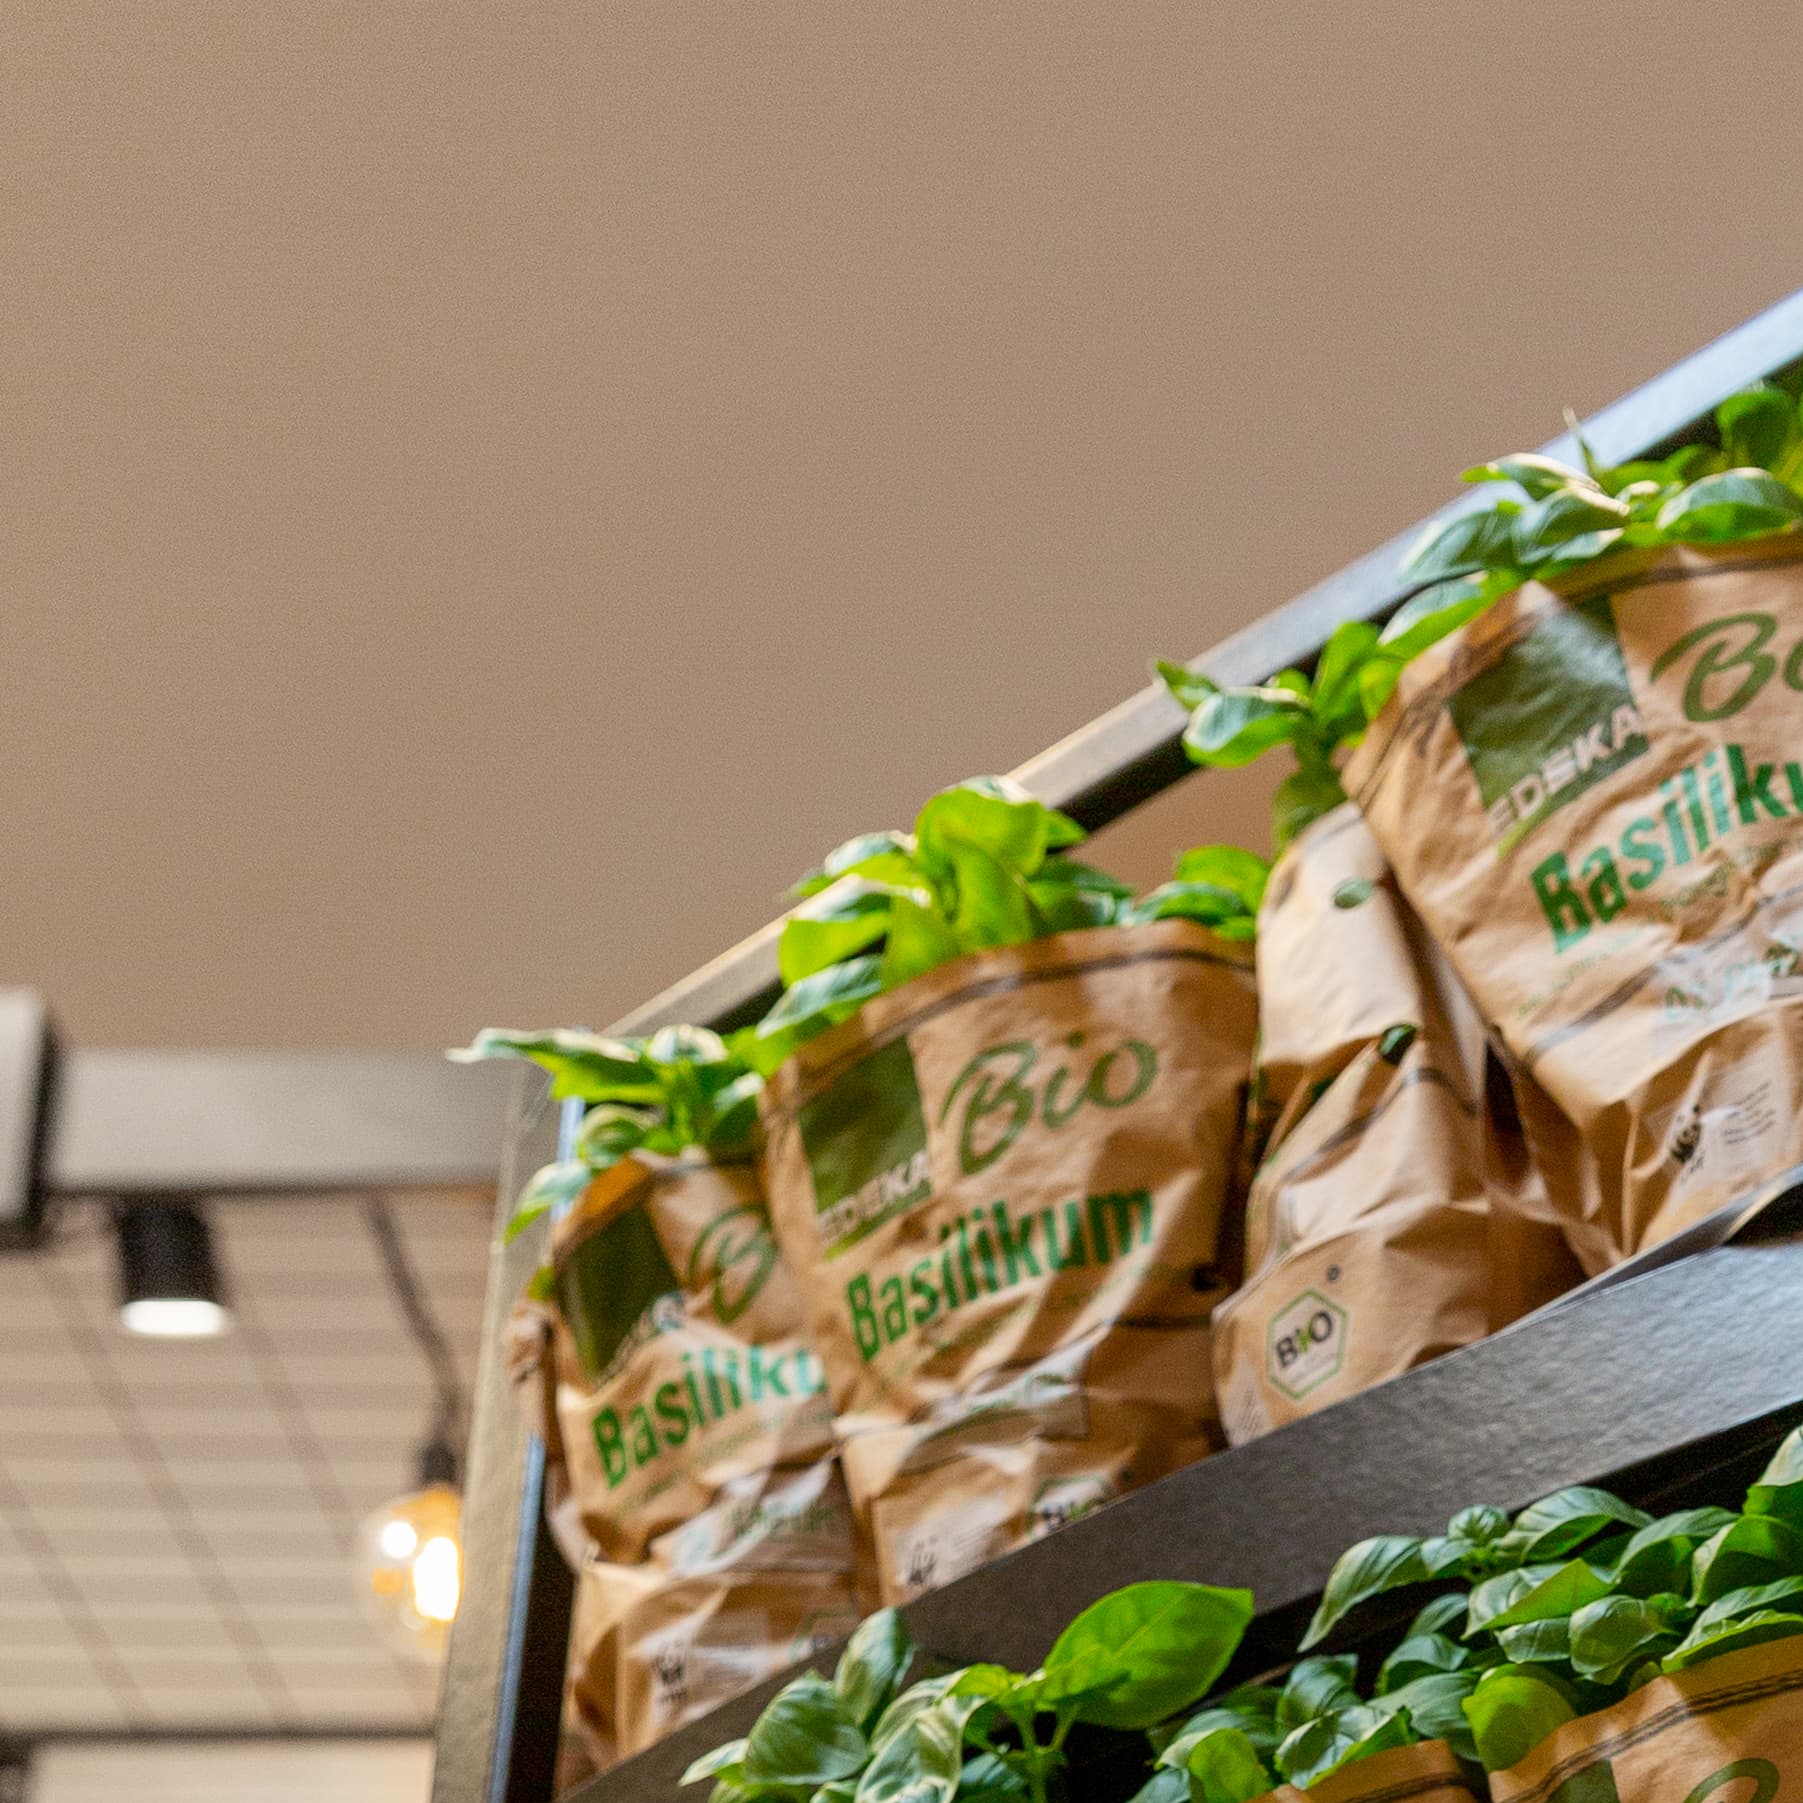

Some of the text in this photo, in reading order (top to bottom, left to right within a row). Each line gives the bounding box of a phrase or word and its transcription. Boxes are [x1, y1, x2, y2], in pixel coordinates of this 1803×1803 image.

[937, 1031, 1159, 1176] Bio
[845, 1189, 1154, 1364] Basilikum
[590, 1344, 827, 1488] Basiliku
